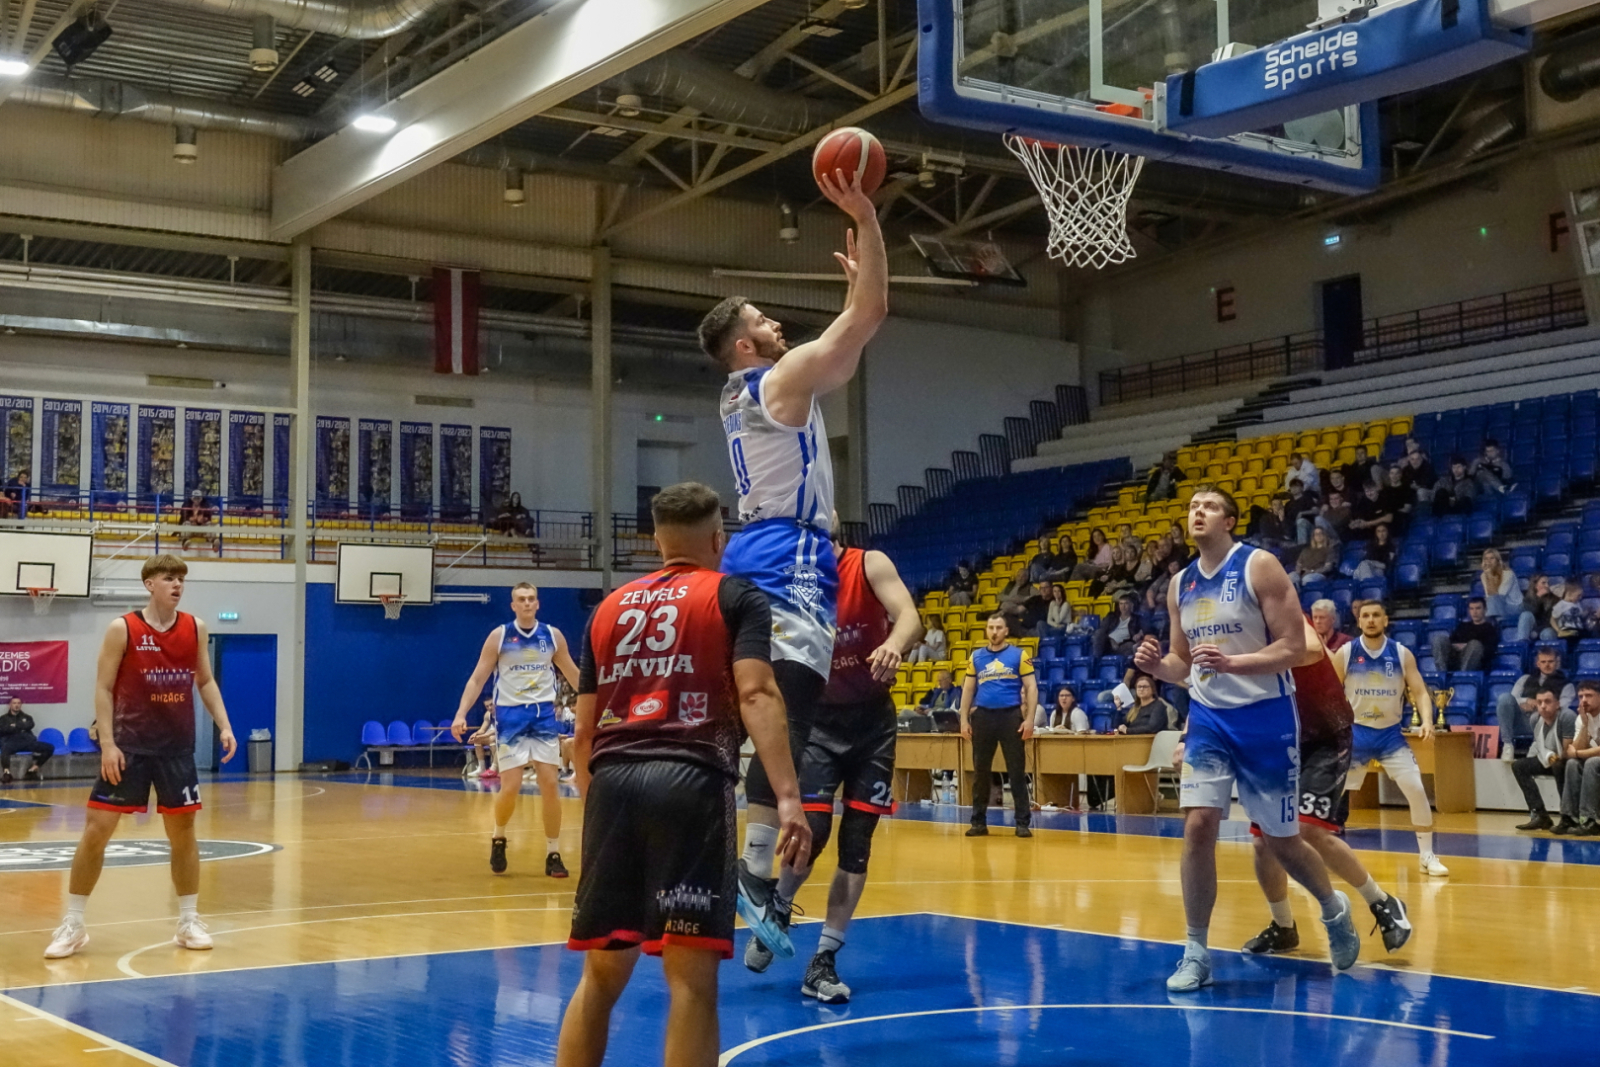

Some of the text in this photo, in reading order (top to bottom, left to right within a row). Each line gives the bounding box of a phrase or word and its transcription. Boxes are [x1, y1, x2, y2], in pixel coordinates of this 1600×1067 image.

[1265, 31, 1358, 70] Schelde
[1264, 50, 1358, 90] Sports
[1549, 211, 1570, 253] F
[1216, 286, 1236, 323] E
[0, 397, 33, 409] 012/2013
[43, 400, 81, 412] 2013/2014
[92, 403, 129, 415] 2014/2015
[138, 407, 175, 419] 2015/2016
[185, 410, 221, 421] 2016/2017
[230, 413, 265, 424] 2017/2018
[316, 418, 350, 430] 2019/2020
[359, 421, 392, 432] 2020/2021
[400, 424, 432, 435] 2021/2022
[440, 427, 472, 438] 2022/2023
[480, 429, 511, 440] 2023/2024
[1220, 578, 1238, 604] 15
[615, 604, 679, 657] 23
[141, 634, 155, 646] 11
[539, 639, 547, 653] 9
[0, 651, 30, 660] ZEMES
[0, 659, 31, 673] DIO
[598, 653, 694, 686] LATVIJA
[1385, 661, 1394, 678] 2
[1355, 688, 1397, 696] VENTSPILS
[1280, 795, 1295, 823] 15
[1299, 792, 1332, 820] 33
